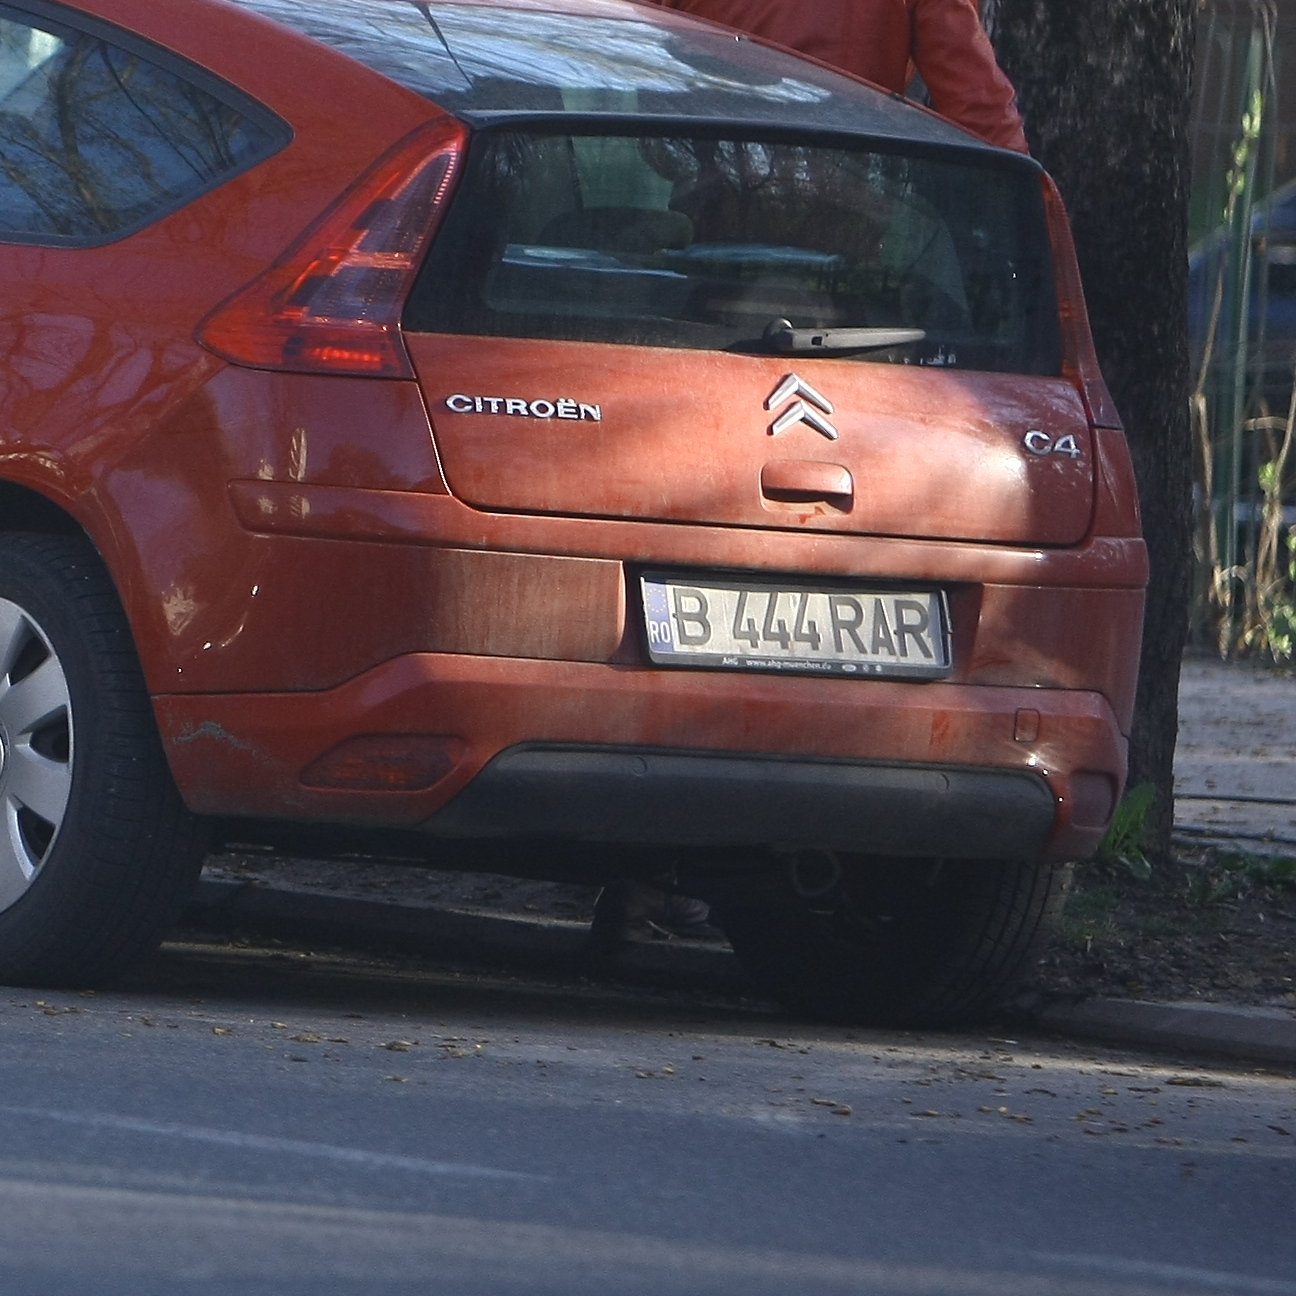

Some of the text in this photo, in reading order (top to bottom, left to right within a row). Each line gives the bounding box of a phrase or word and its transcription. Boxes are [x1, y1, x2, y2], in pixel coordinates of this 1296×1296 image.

[445, 393, 602, 422] CITROËN
[1023, 429, 1081, 459] C4
[649, 620, 671, 644] RO
[673, 587, 934, 658] B 444 RAR
